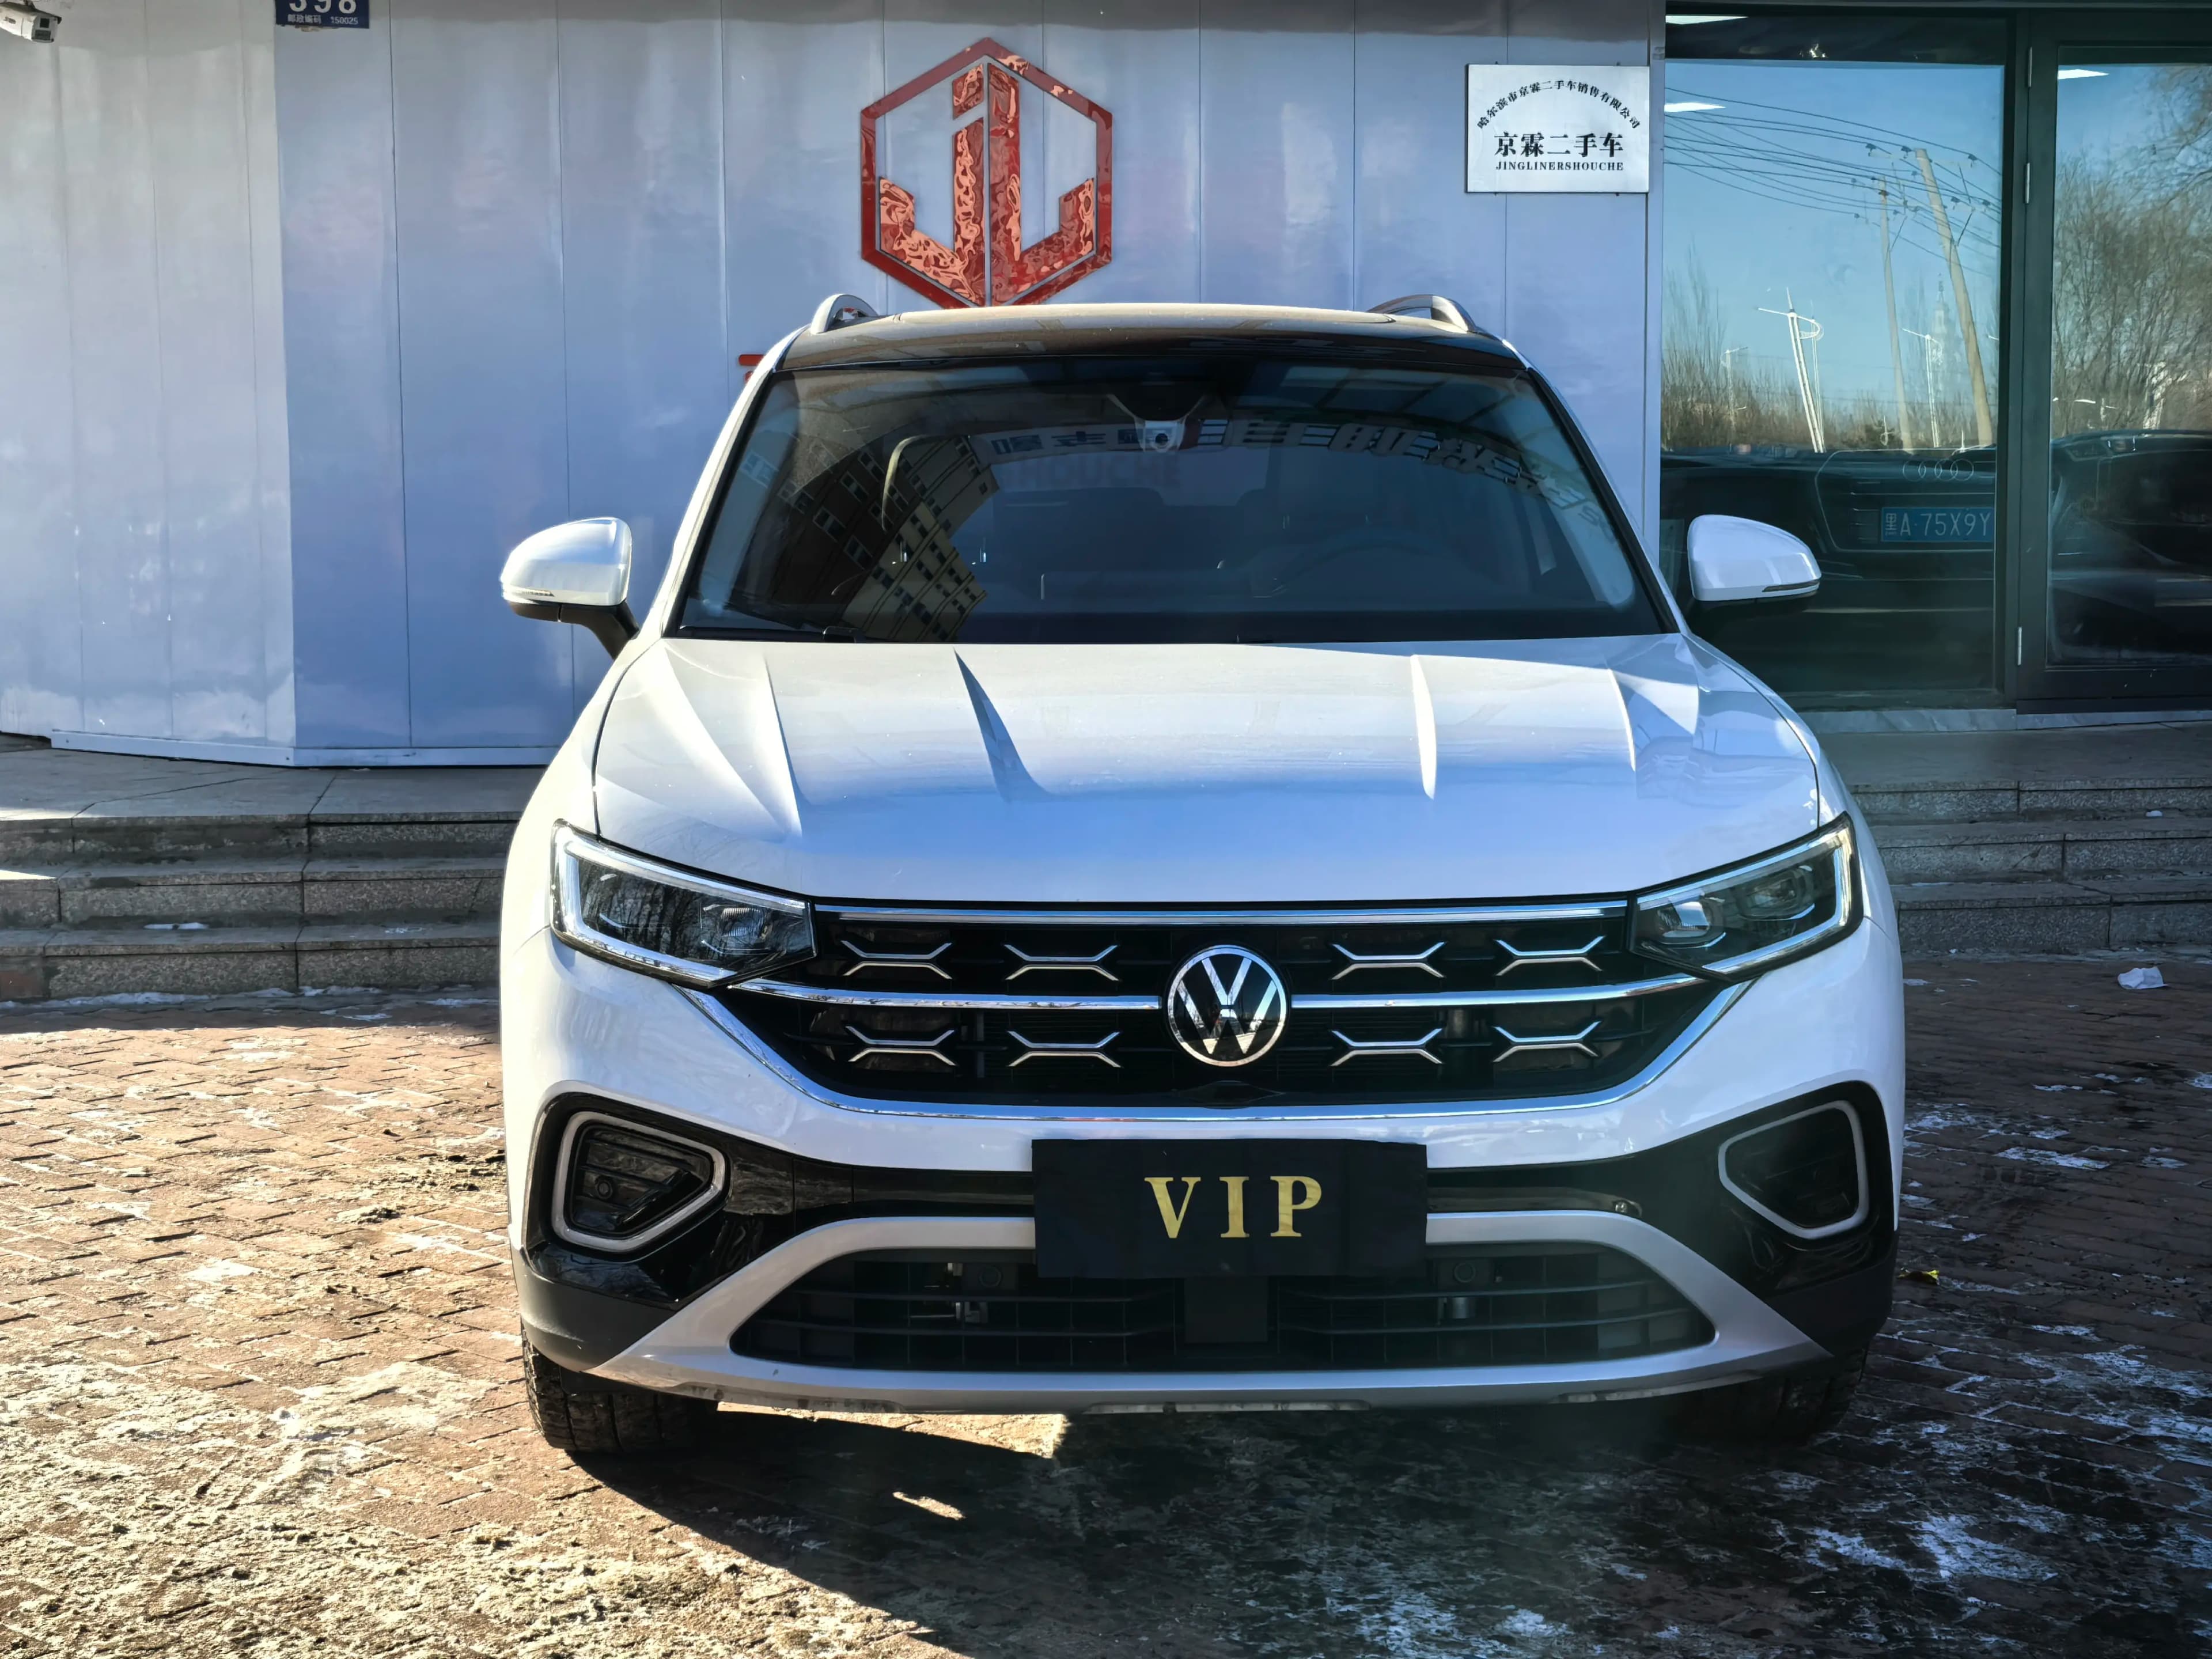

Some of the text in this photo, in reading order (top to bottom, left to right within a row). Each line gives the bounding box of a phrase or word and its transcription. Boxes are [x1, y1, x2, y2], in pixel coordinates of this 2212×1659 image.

[330, 16, 359, 24] 150025
[1477, 80, 1641, 129] 哈尔滨市京霖二手车销售有限公司
[1494, 131, 1624, 157] 京霖二手车
[1495, 161, 1623, 171] JINGLINERSHOUCHE
[1144, 1176, 1322, 1238] VIP
